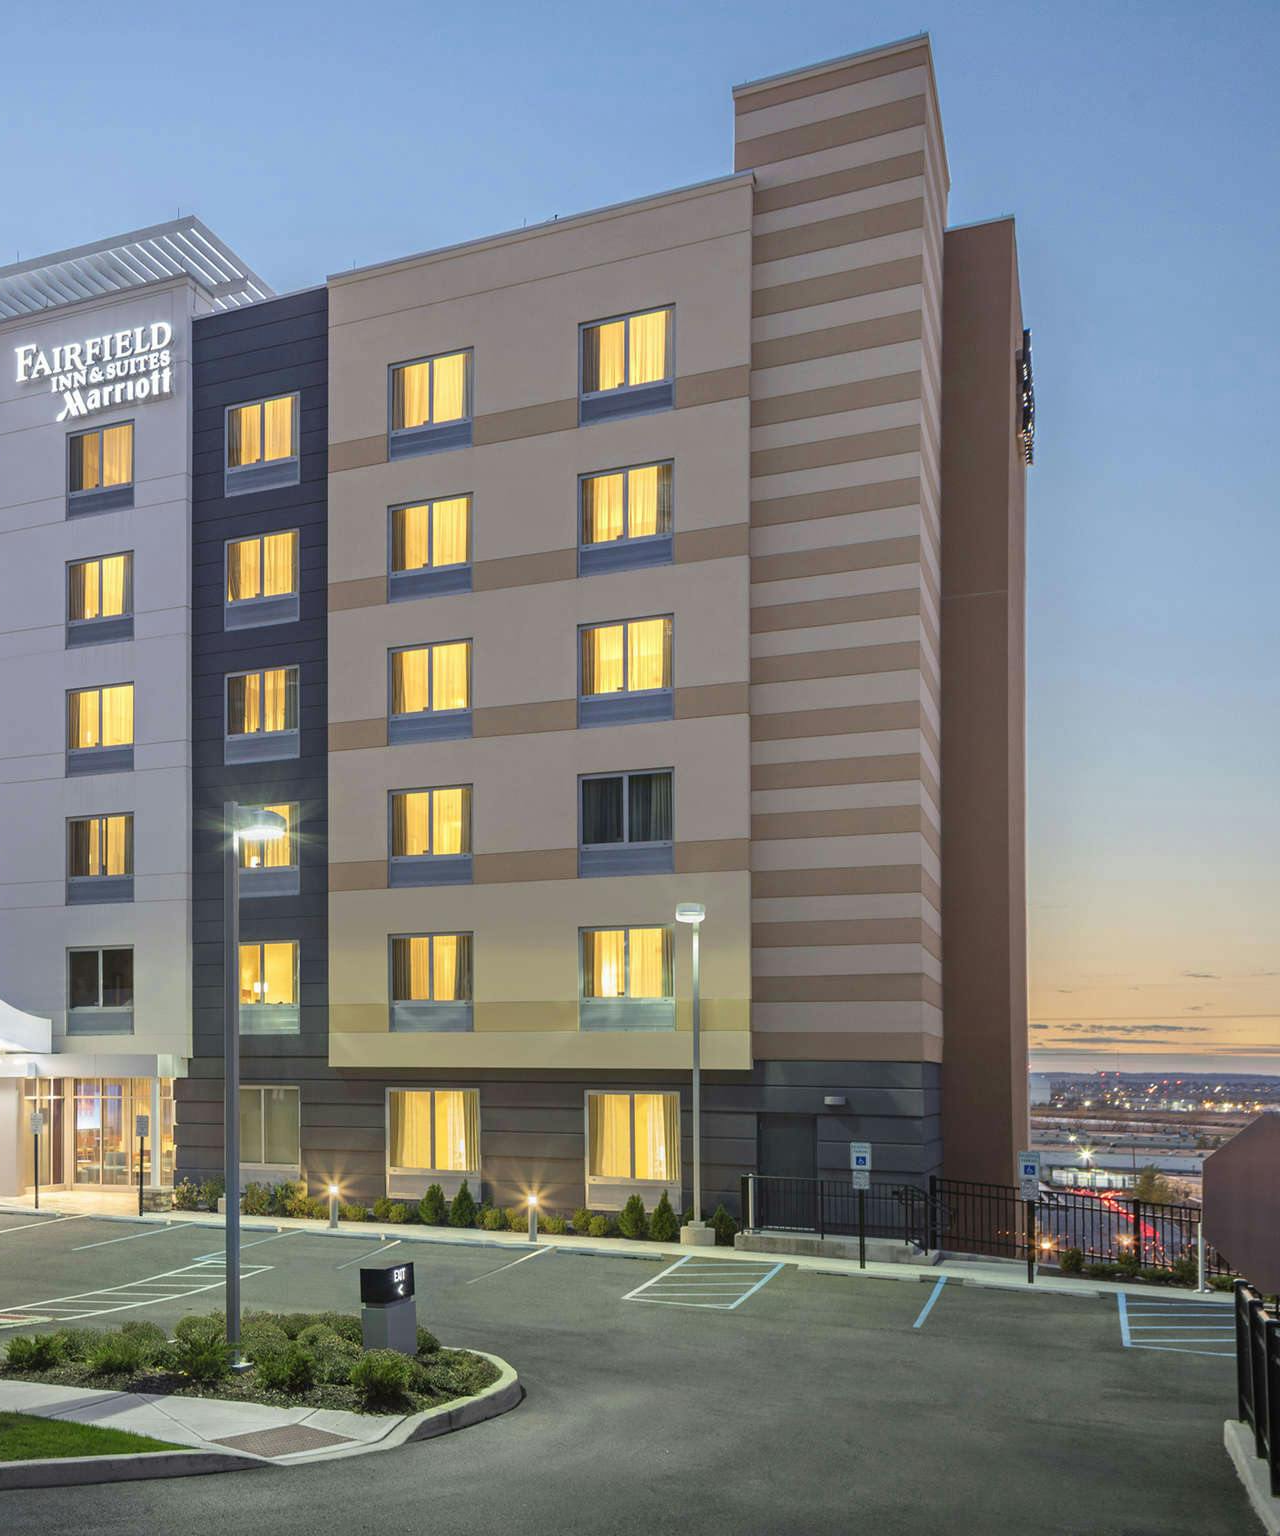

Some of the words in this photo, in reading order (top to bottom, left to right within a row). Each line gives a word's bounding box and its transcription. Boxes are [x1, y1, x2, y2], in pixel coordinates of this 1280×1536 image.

[14, 322, 172, 382] FAIRFIELD
[51, 370, 87, 392] INN
[89, 366, 104, 383] &
[106, 350, 171, 379] SUITES
[56, 367, 172, 422] Marriott
